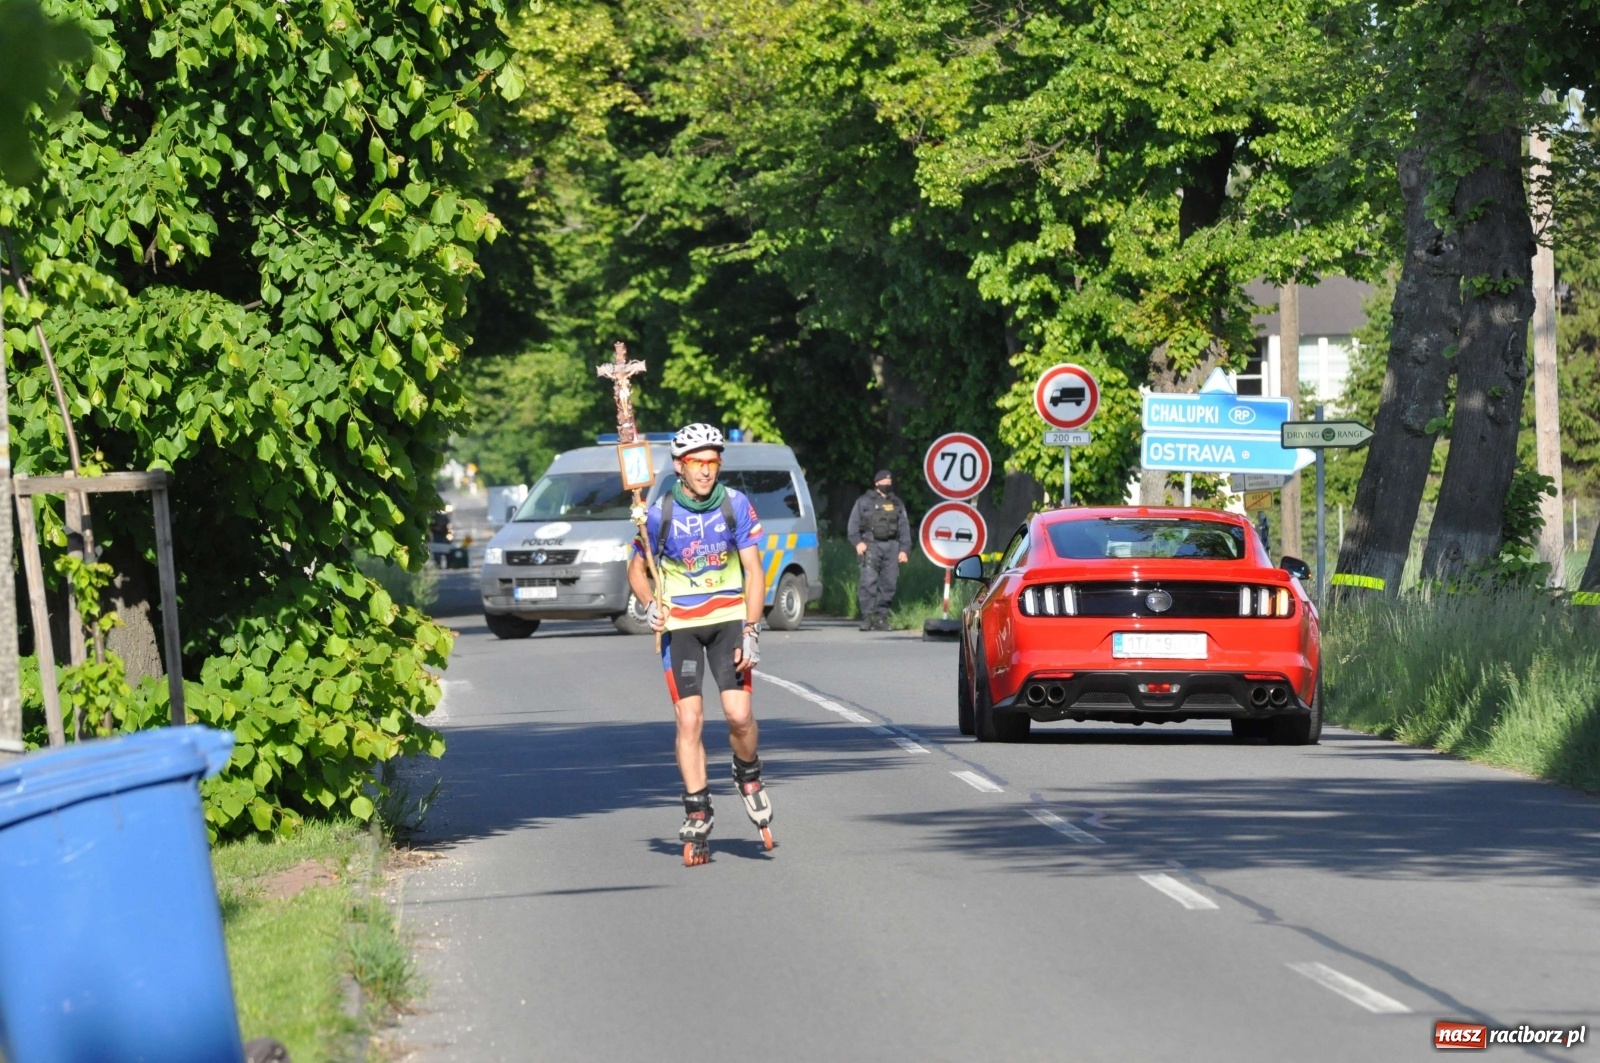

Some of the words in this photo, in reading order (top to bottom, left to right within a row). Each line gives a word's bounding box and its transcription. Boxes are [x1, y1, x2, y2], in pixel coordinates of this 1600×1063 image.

[1151, 405, 1219, 424] CHALUPKI
[1234, 409, 1250, 421] RP
[1053, 434, 1070, 442] 200
[1286, 431, 1320, 440] DRIVING
[1337, 430, 1364, 438] RANGE
[1149, 442, 1236, 463] OSTRAVA
[940, 452, 977, 482] 70
[521, 538, 566, 547] POLICIE
[683, 551, 728, 571] YBBS
